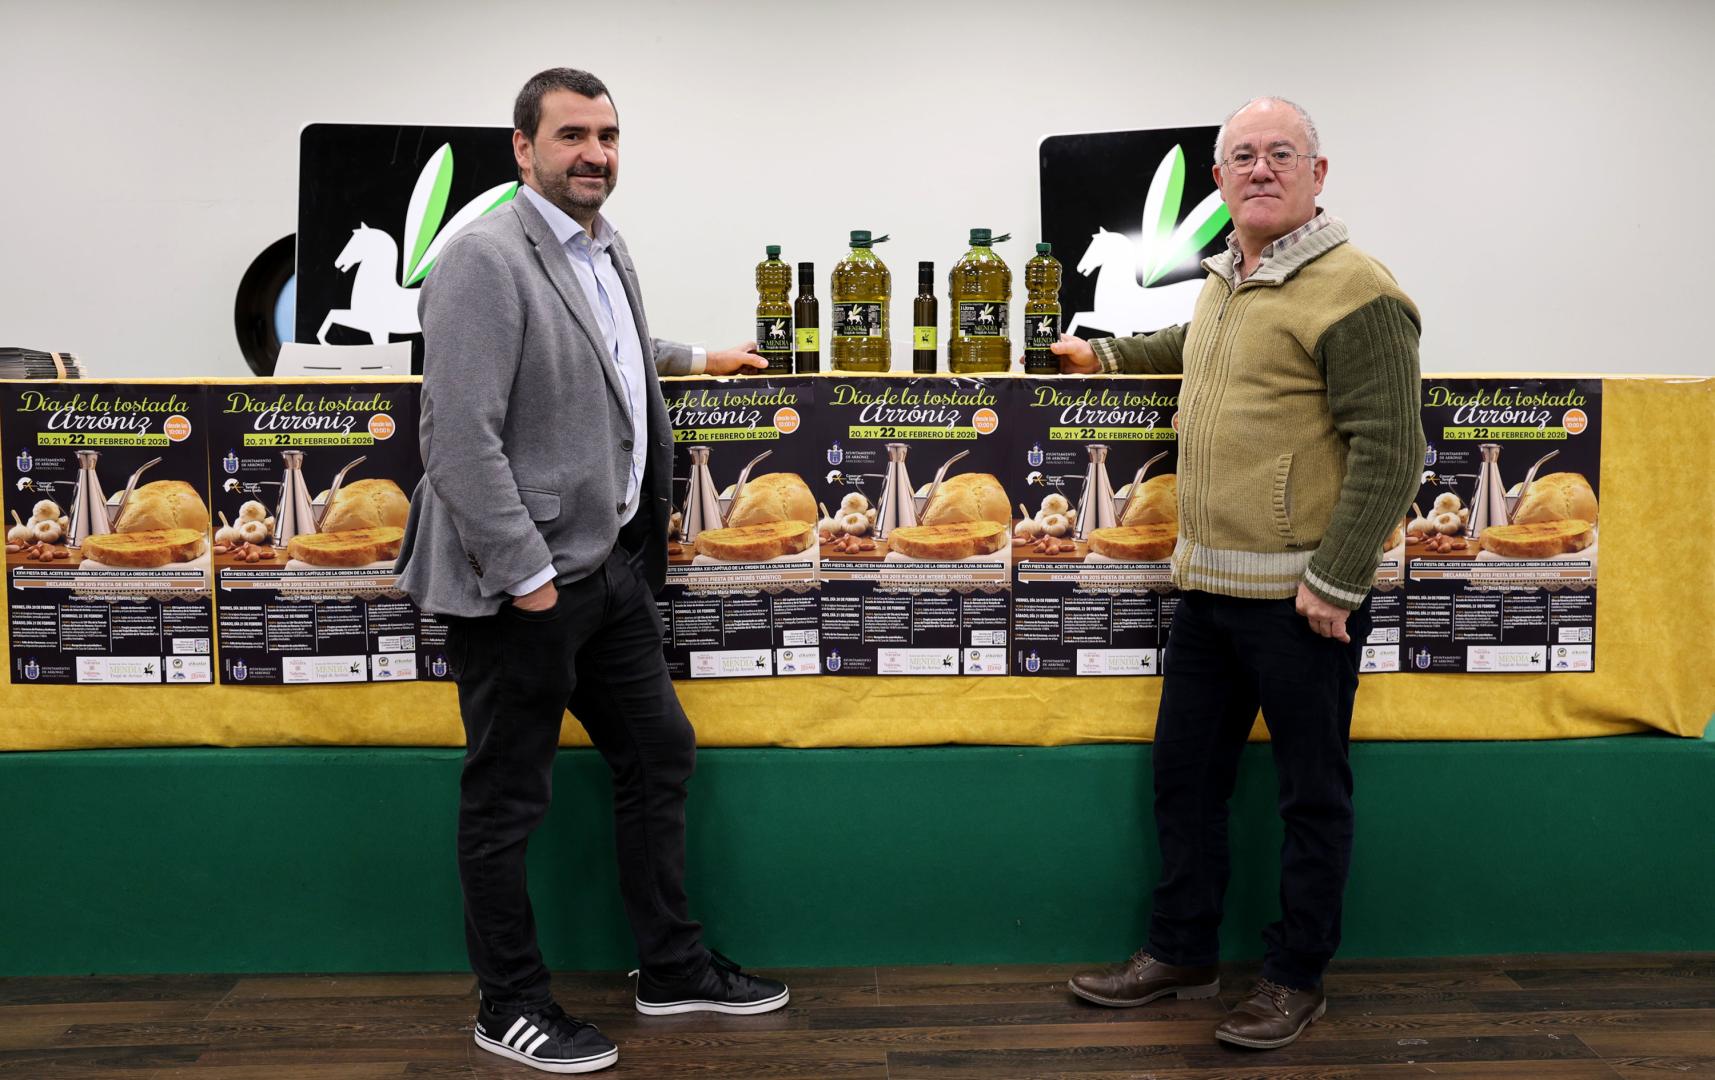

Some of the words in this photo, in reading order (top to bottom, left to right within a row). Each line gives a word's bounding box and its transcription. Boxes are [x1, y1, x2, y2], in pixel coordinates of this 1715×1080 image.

[17, 391, 62, 412] Día
[68, 394, 89, 412] de
[89, 394, 110, 412] la
[115, 394, 189, 412] tostada
[223, 392, 268, 413] Día
[273, 394, 294, 412] de
[295, 393, 316, 412] la
[318, 393, 393, 412] tostada
[674, 390, 698, 408] de
[701, 389, 721, 407] la
[723, 387, 798, 407] tostada
[829, 385, 873, 405] Día
[878, 387, 899, 406] de
[901, 387, 921, 405] la
[923, 387, 997, 406] tostada
[1030, 386, 1072, 406] Día
[1078, 389, 1098, 407] de
[1100, 388, 1121, 406] la
[1123, 391, 1180, 407] tosta
[1424, 387, 1465, 407] Día
[1472, 389, 1491, 407] de
[1493, 389, 1514, 407] la
[1515, 388, 1587, 407] tostada
[47, 406, 152, 437] Arróniz
[254, 407, 357, 436] Arróniz
[859, 400, 961, 429] Arróniz
[1060, 401, 1160, 431] Arróniz
[1453, 401, 1552, 430] Arróniz
[69, 434, 85, 444] 22
[275, 435, 290, 445] 22
[681, 431, 696, 441] 22
[880, 428, 895, 438] 22
[1080, 429, 1095, 439] 22
[1474, 428, 1488, 438] 22
